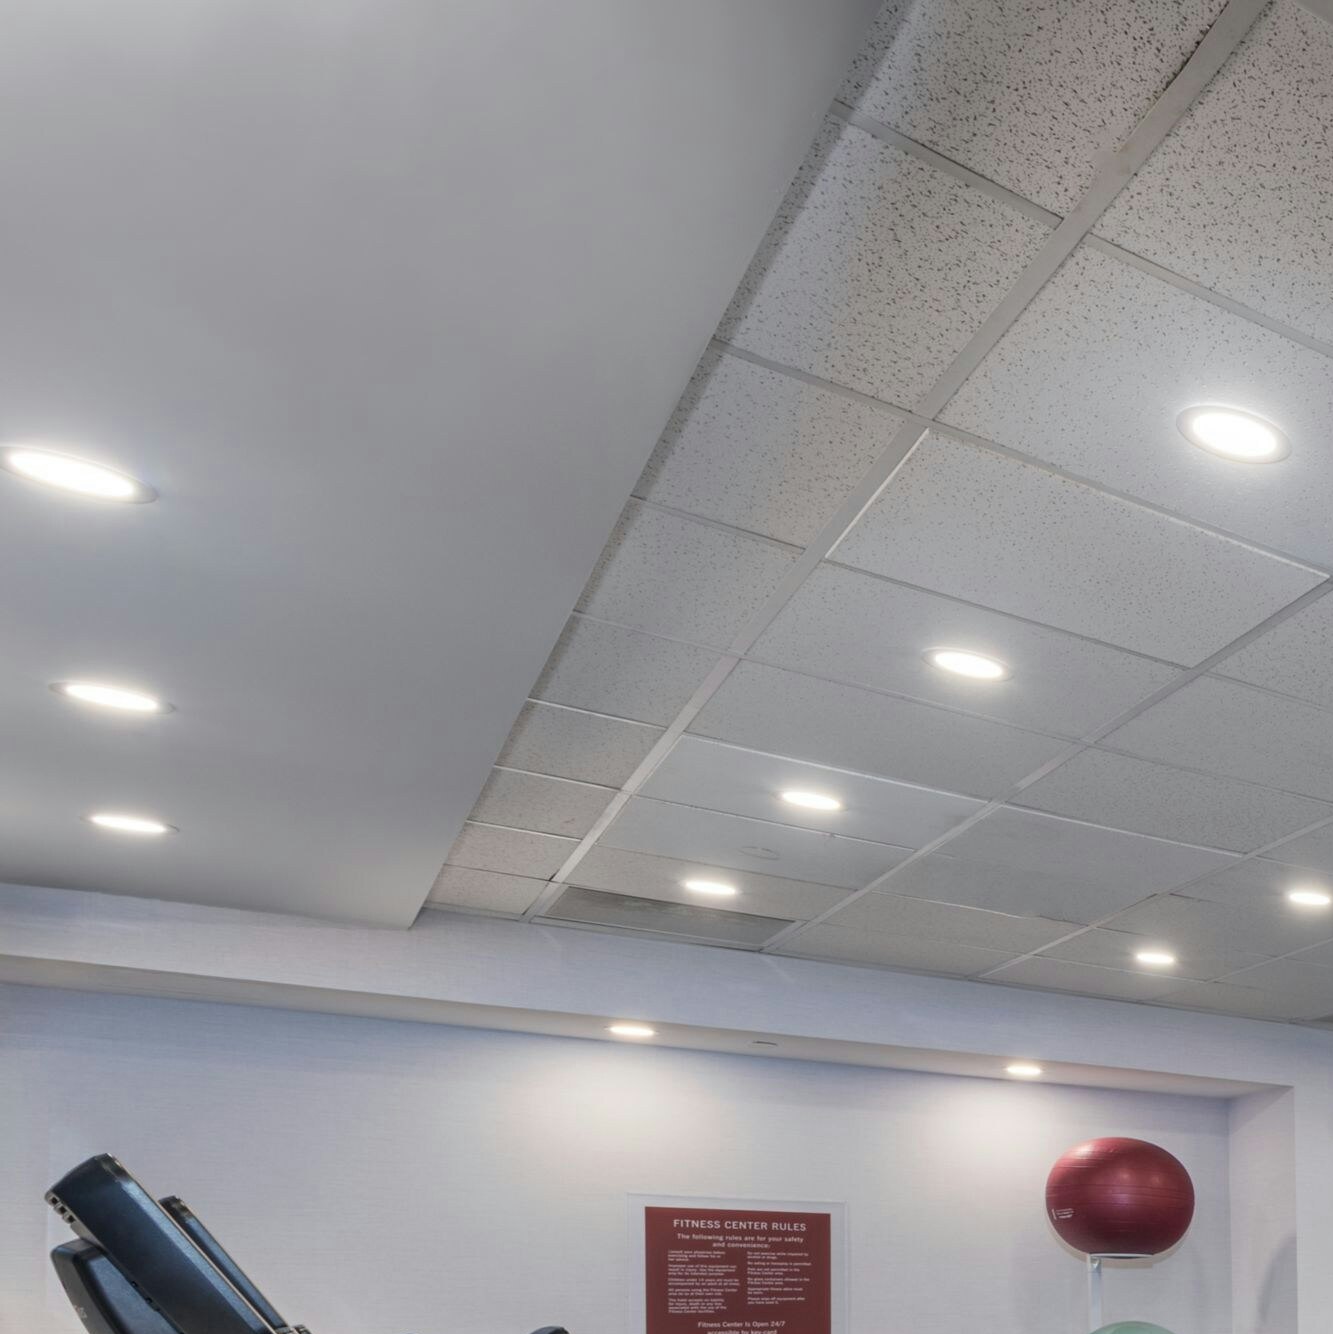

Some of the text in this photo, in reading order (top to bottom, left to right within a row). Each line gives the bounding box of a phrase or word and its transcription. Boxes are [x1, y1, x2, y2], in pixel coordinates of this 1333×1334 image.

[673, 1219, 807, 1232] FITNESS CENTER RULES
[692, 1233, 723, 1242] following
[785, 1236, 804, 1244] safety
